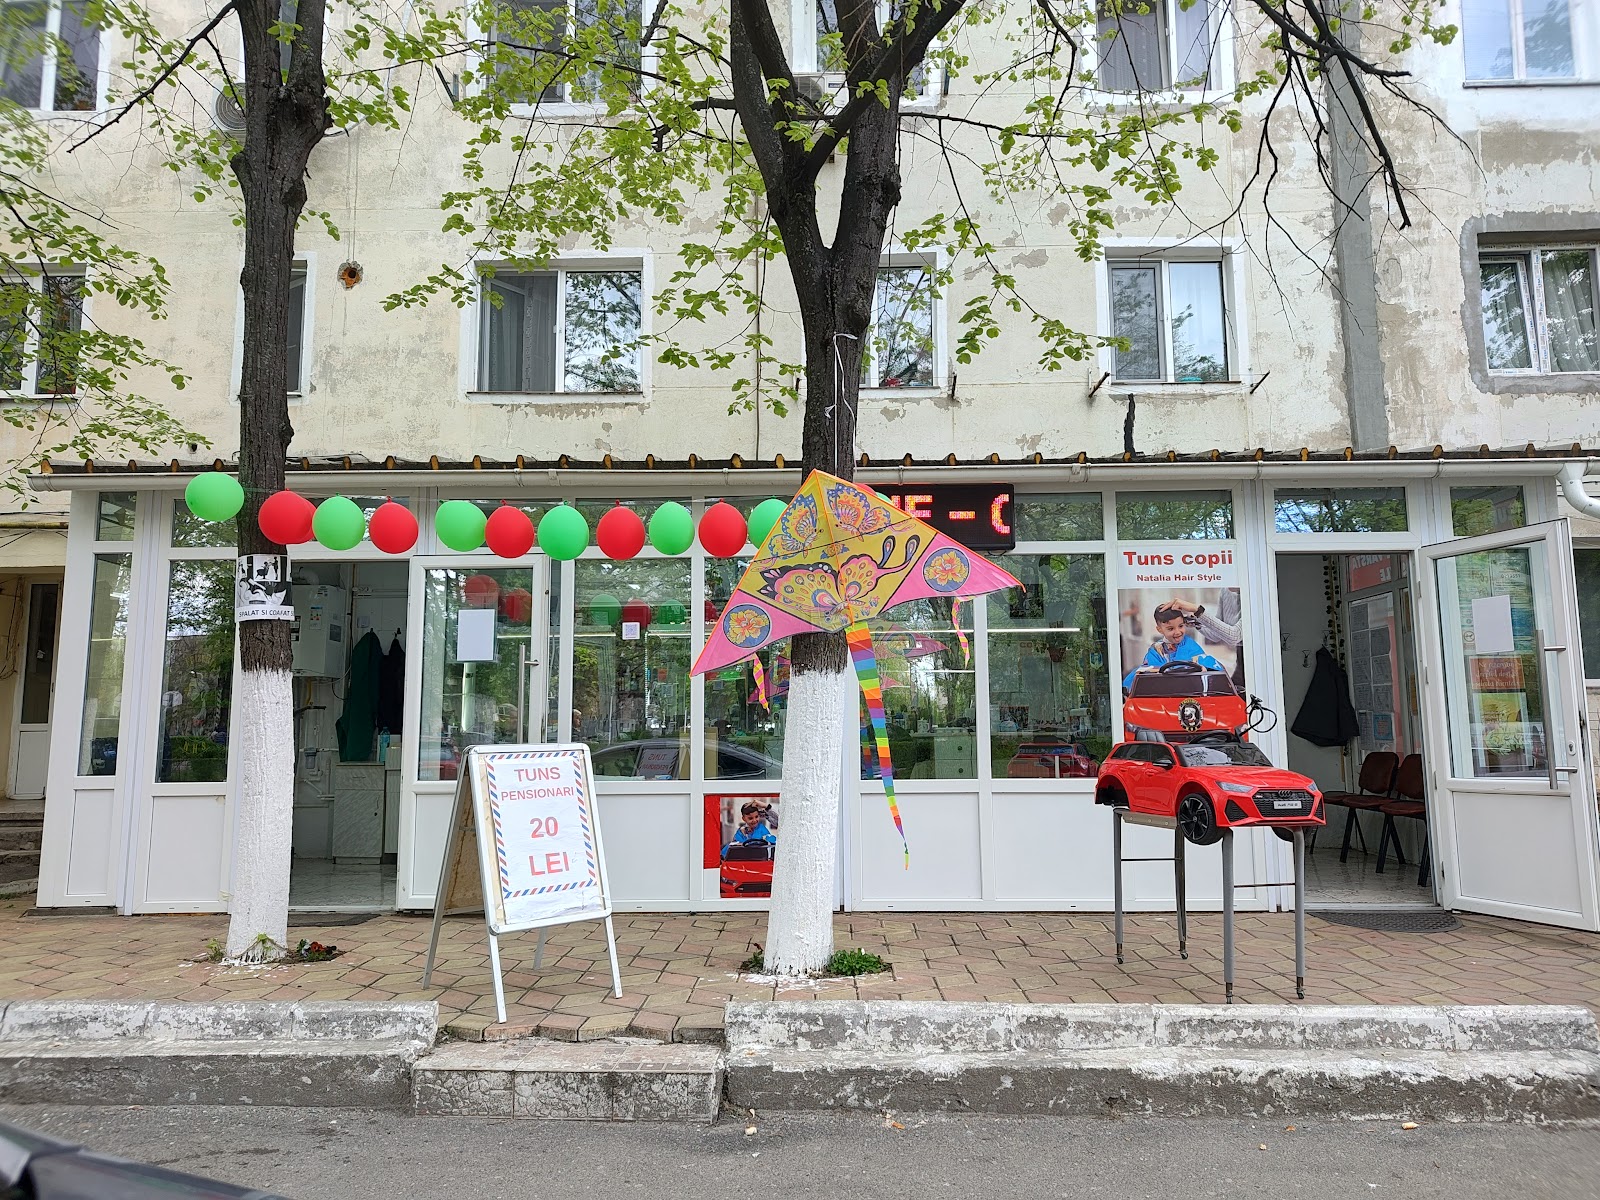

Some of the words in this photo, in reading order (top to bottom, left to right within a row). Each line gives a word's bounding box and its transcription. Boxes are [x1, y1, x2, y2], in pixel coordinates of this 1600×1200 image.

[1123, 551, 1174, 565] Tuns
[1181, 550, 1232, 568] copii
[1136, 574, 1171, 582] Natalia
[1197, 574, 1222, 582] Style
[239, 609, 259, 617] SPALAT
[514, 767, 561, 782] TUNS
[501, 787, 574, 801] PENSIONARI
[529, 816, 559, 839] 20
[528, 851, 570, 876] LEI
